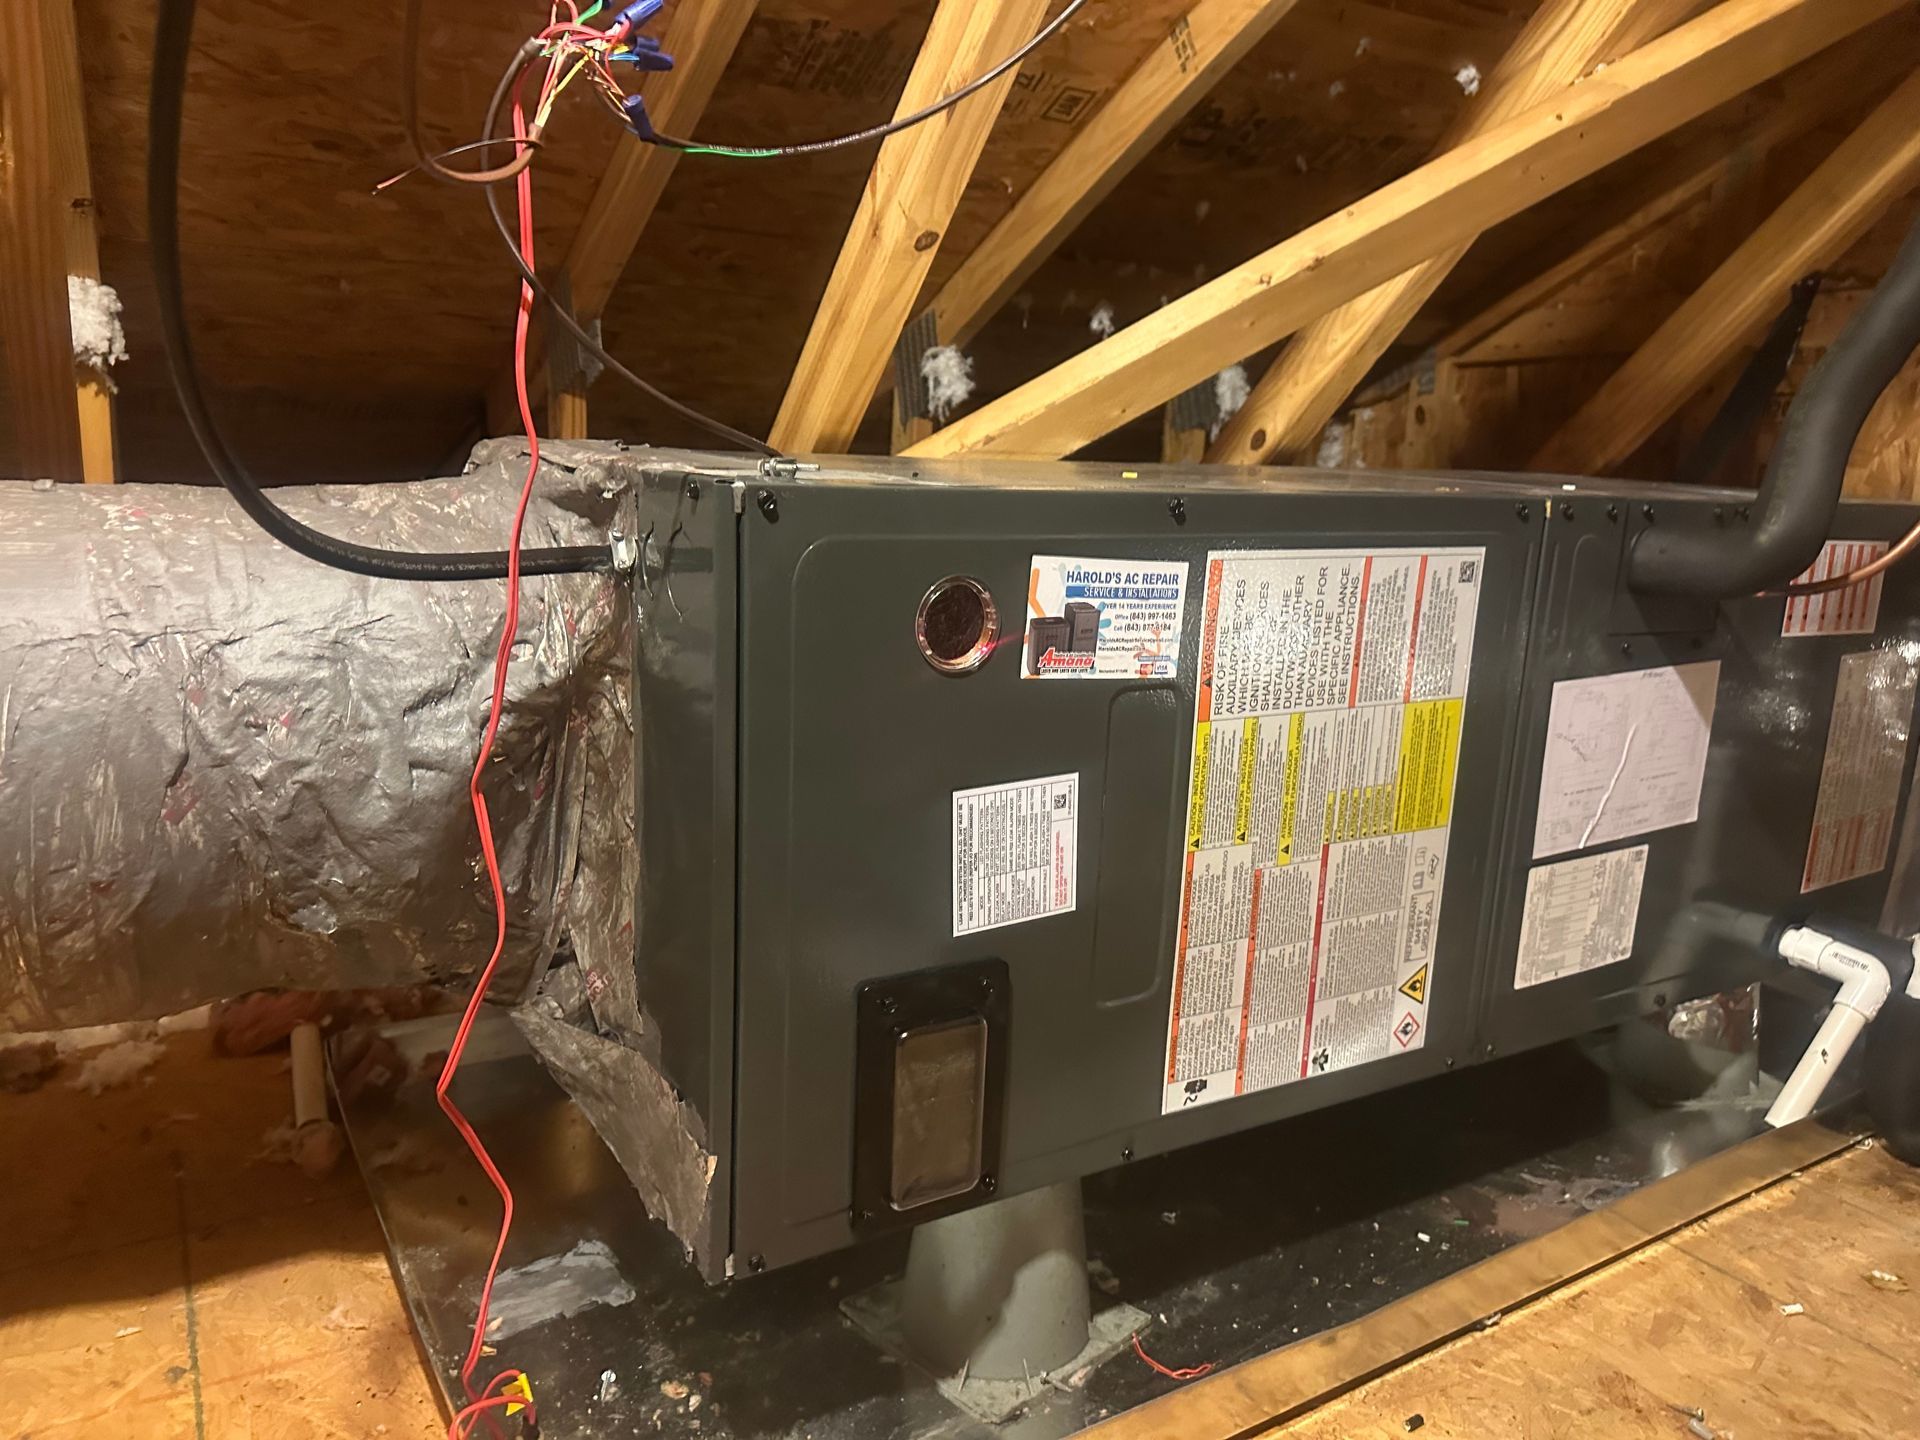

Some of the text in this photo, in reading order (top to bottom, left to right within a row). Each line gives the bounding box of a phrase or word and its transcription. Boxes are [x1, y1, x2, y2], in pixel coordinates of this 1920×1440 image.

[1066, 571, 1179, 585] HAROLD'S AC REPAIR
[1084, 587, 1177, 598] SERVICE & INSTALLATIONS
[1281, 589, 1291, 616] THE
[1203, 608, 1216, 674] WARNING
[1283, 575, 1304, 708] DUCTWO OTHER
[1305, 566, 1328, 707] DEVICES LISTED FOR
[1326, 563, 1350, 704] SPECIFIC APPLIANCE.
[1337, 572, 1360, 704] SEE INSTRUCTIONS.
[1037, 646, 1095, 668] Amana
[1214, 625, 1229, 715] RISK OF FIRE
[1226, 643, 1240, 714] AUXILIARY
[1316, 611, 1333, 706] USE WITH THE
[1237, 667, 1249, 713] WHICH
[1249, 653, 1262, 711] IGNITION
[1260, 669, 1272, 711] SHALL
[1294, 672, 1305, 706] THAN
[1240, 738, 1248, 784] INSTALLEUR
[1285, 749, 1293, 795] INSTALADOR
[1290, 756, 1298, 798] FUNCIONAR
[1289, 801, 1294, 809] DE
[1216, 874, 1221, 883] DE
[1208, 904, 1212, 913] DE
[1251, 874, 1260, 933] AVERTISSEMENT
[1413, 908, 1423, 944] SAFETY
[1420, 918, 1430, 951] GROUP
